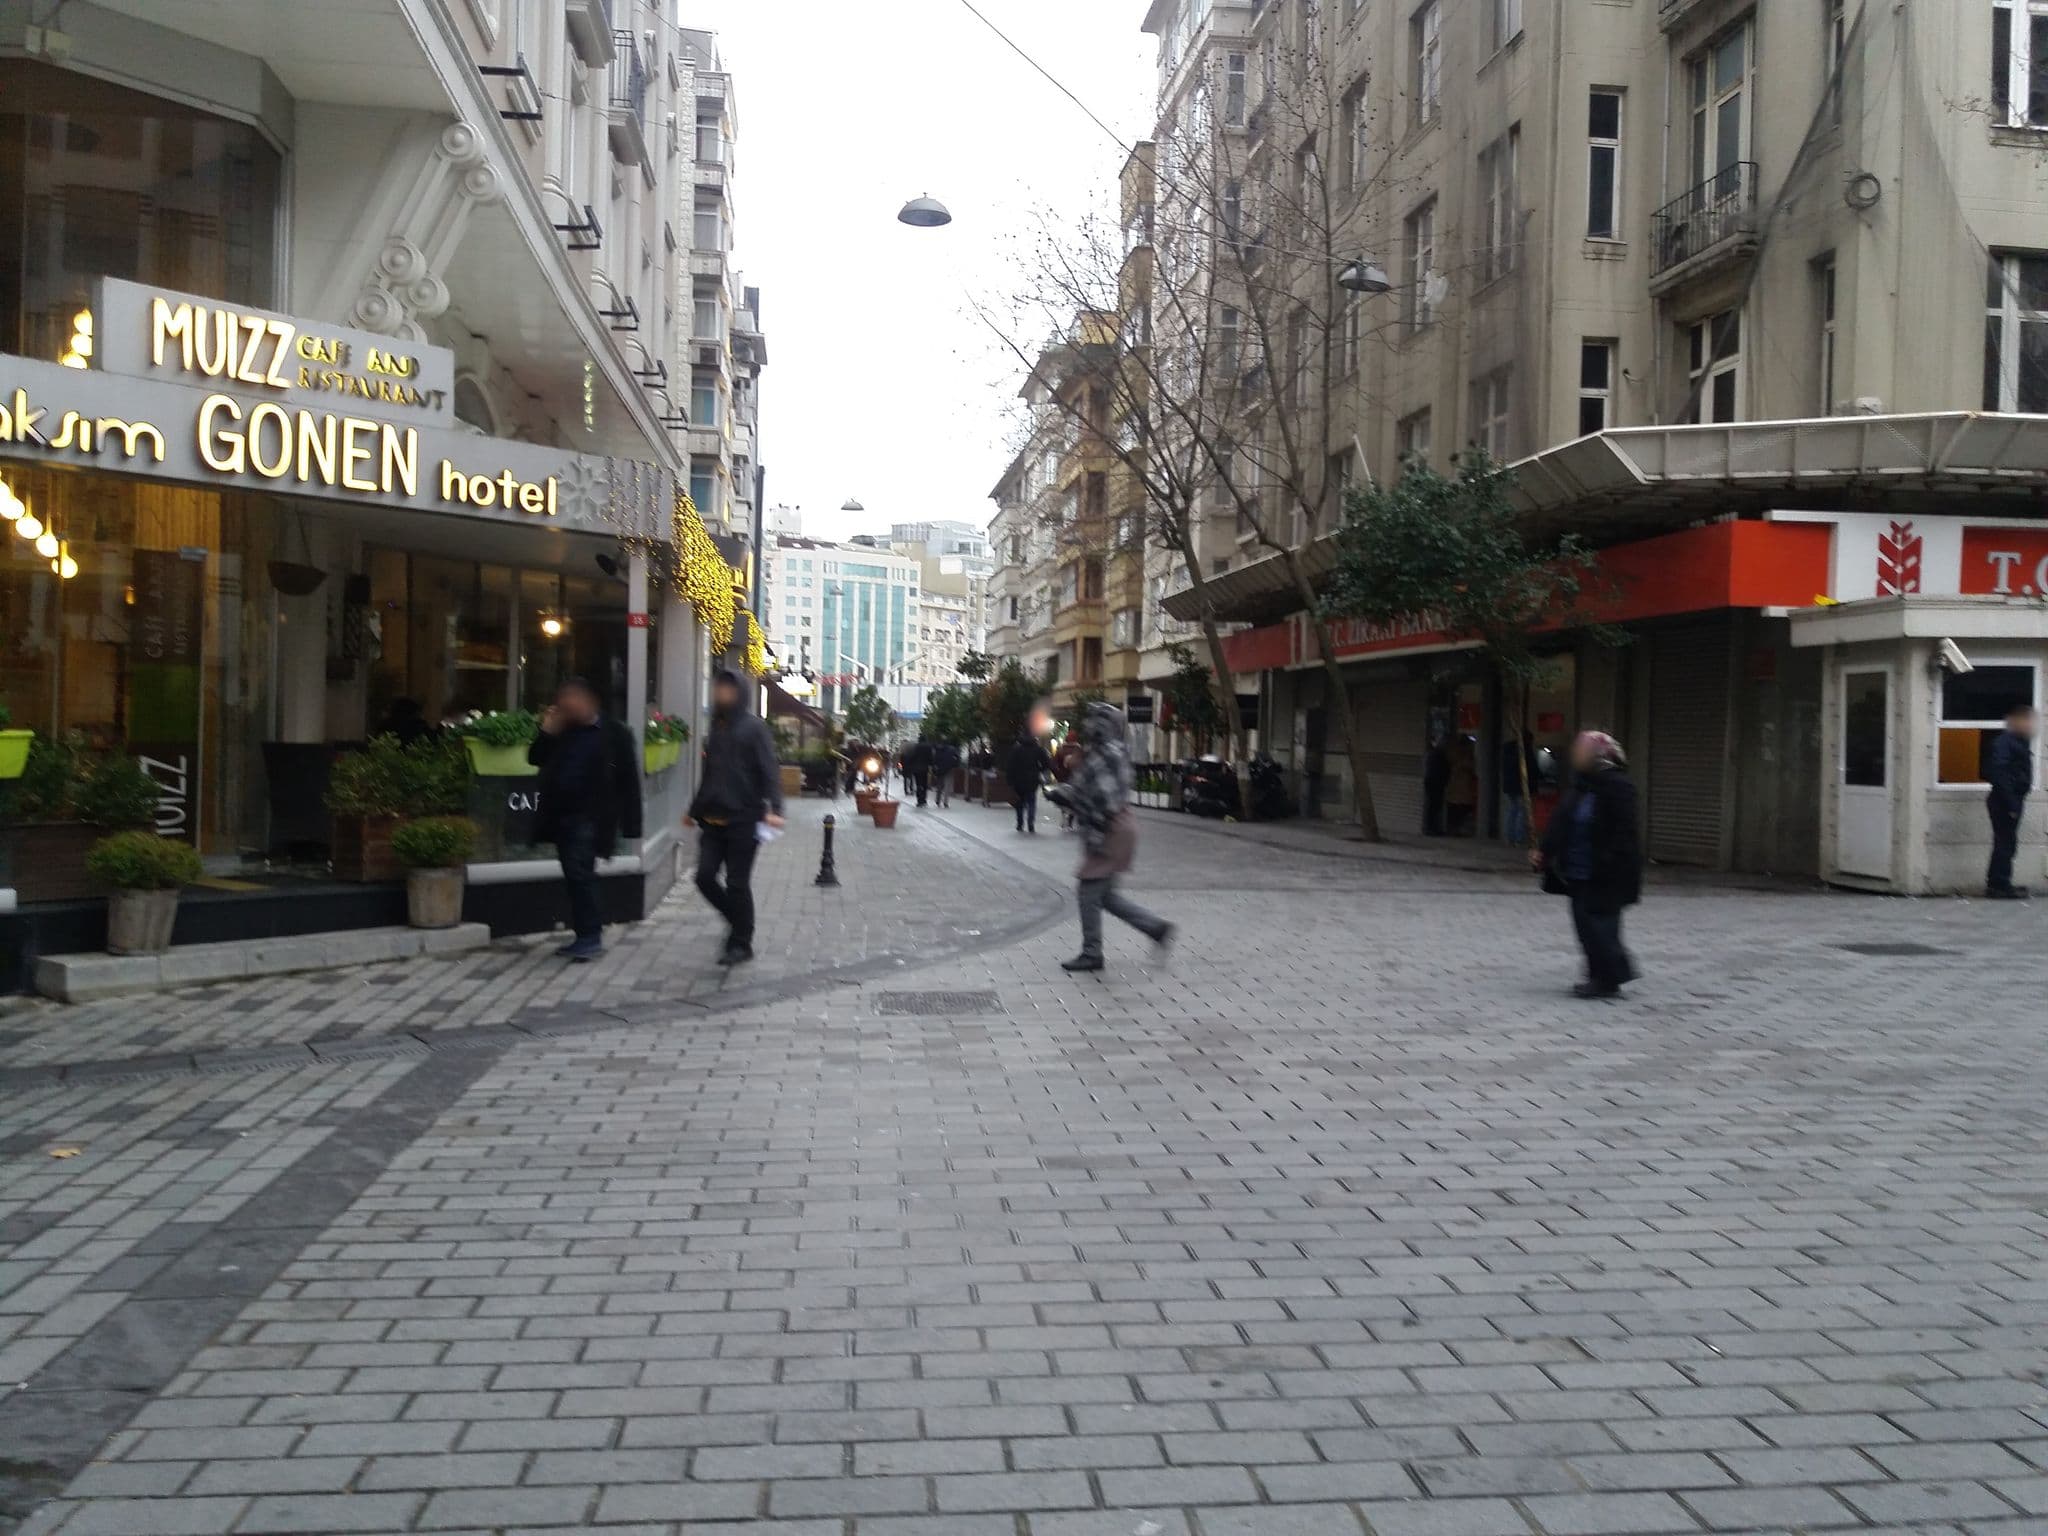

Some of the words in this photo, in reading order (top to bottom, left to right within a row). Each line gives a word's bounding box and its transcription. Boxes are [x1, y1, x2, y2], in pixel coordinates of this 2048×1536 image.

[152, 296, 296, 390] MUIZZ
[367, 346, 420, 378] AND
[198, 393, 419, 497] GONEN
[441, 458, 559, 517] hotel
[508, 791, 541, 812] CAF
